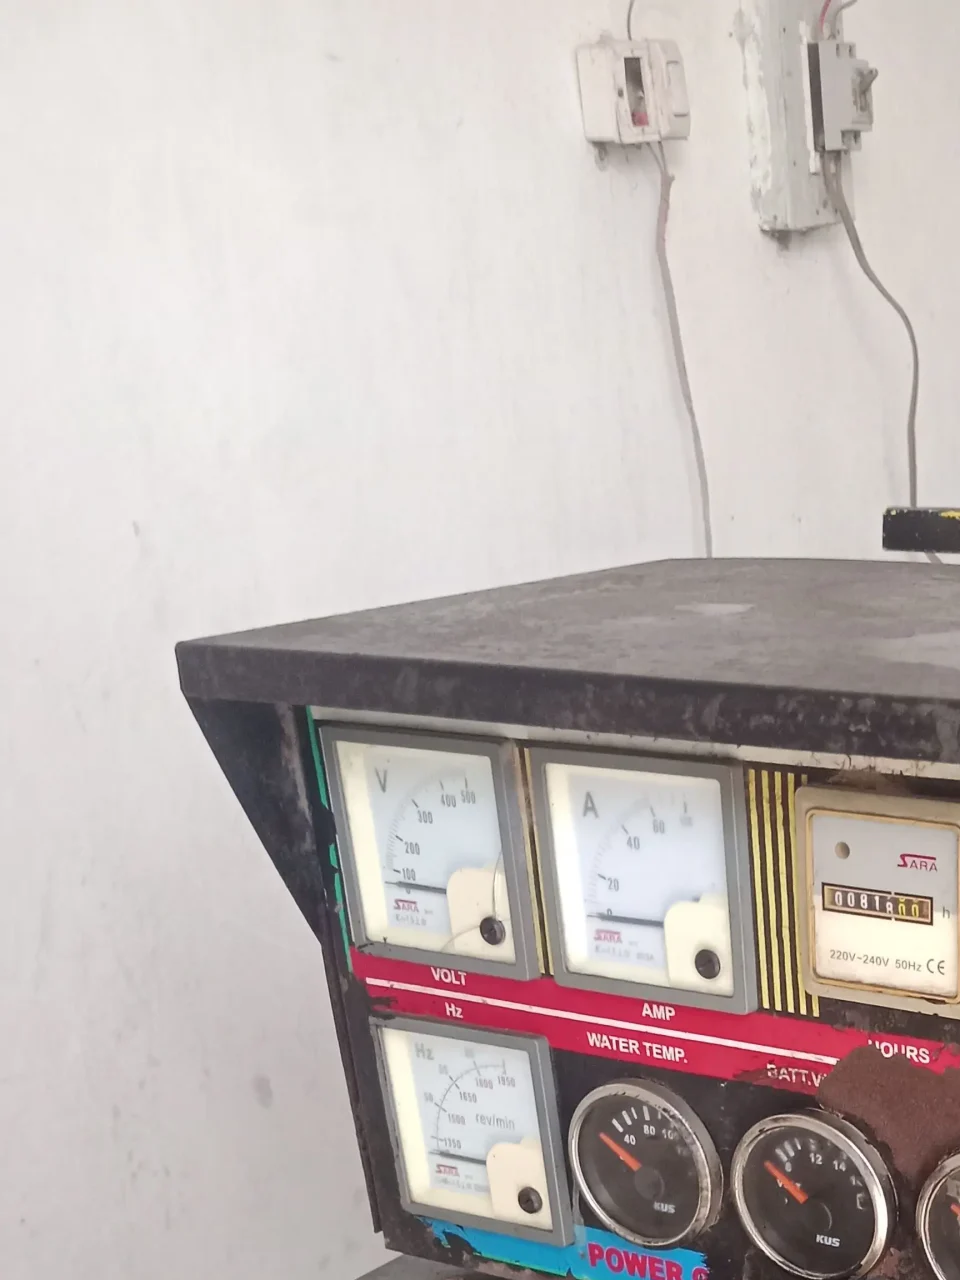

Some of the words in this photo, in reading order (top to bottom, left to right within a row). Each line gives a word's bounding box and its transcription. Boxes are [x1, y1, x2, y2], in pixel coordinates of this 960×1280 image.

[375, 767, 388, 793] V
[440, 793, 456, 808] 400
[461, 791, 476, 804] 500
[583, 791, 599, 818] A
[417, 811, 433, 824] 300
[404, 841, 420, 855] 200
[626, 836, 640, 850] 40
[897, 853, 938, 872] SARA
[402, 868, 416, 881] 100
[607, 878, 619, 891] 20
[942, 906, 951, 919] h
[895, 958, 922, 972] 50Hz
[430, 966, 467, 986] VOLT
[444, 1001, 464, 1019] Hz
[641, 1002, 676, 1021] AMP
[415, 1043, 434, 1060] Hz
[586, 1031, 640, 1055] WATER
[643, 1042, 688, 1064] TEMP.
[475, 1113, 516, 1131] rev/min
[643, 1124, 656, 1136] 80
[624, 1134, 636, 1146] 40
[809, 1152, 822, 1165] 12
[833, 1160, 846, 1172] 14
[815, 1234, 840, 1247] KUS
